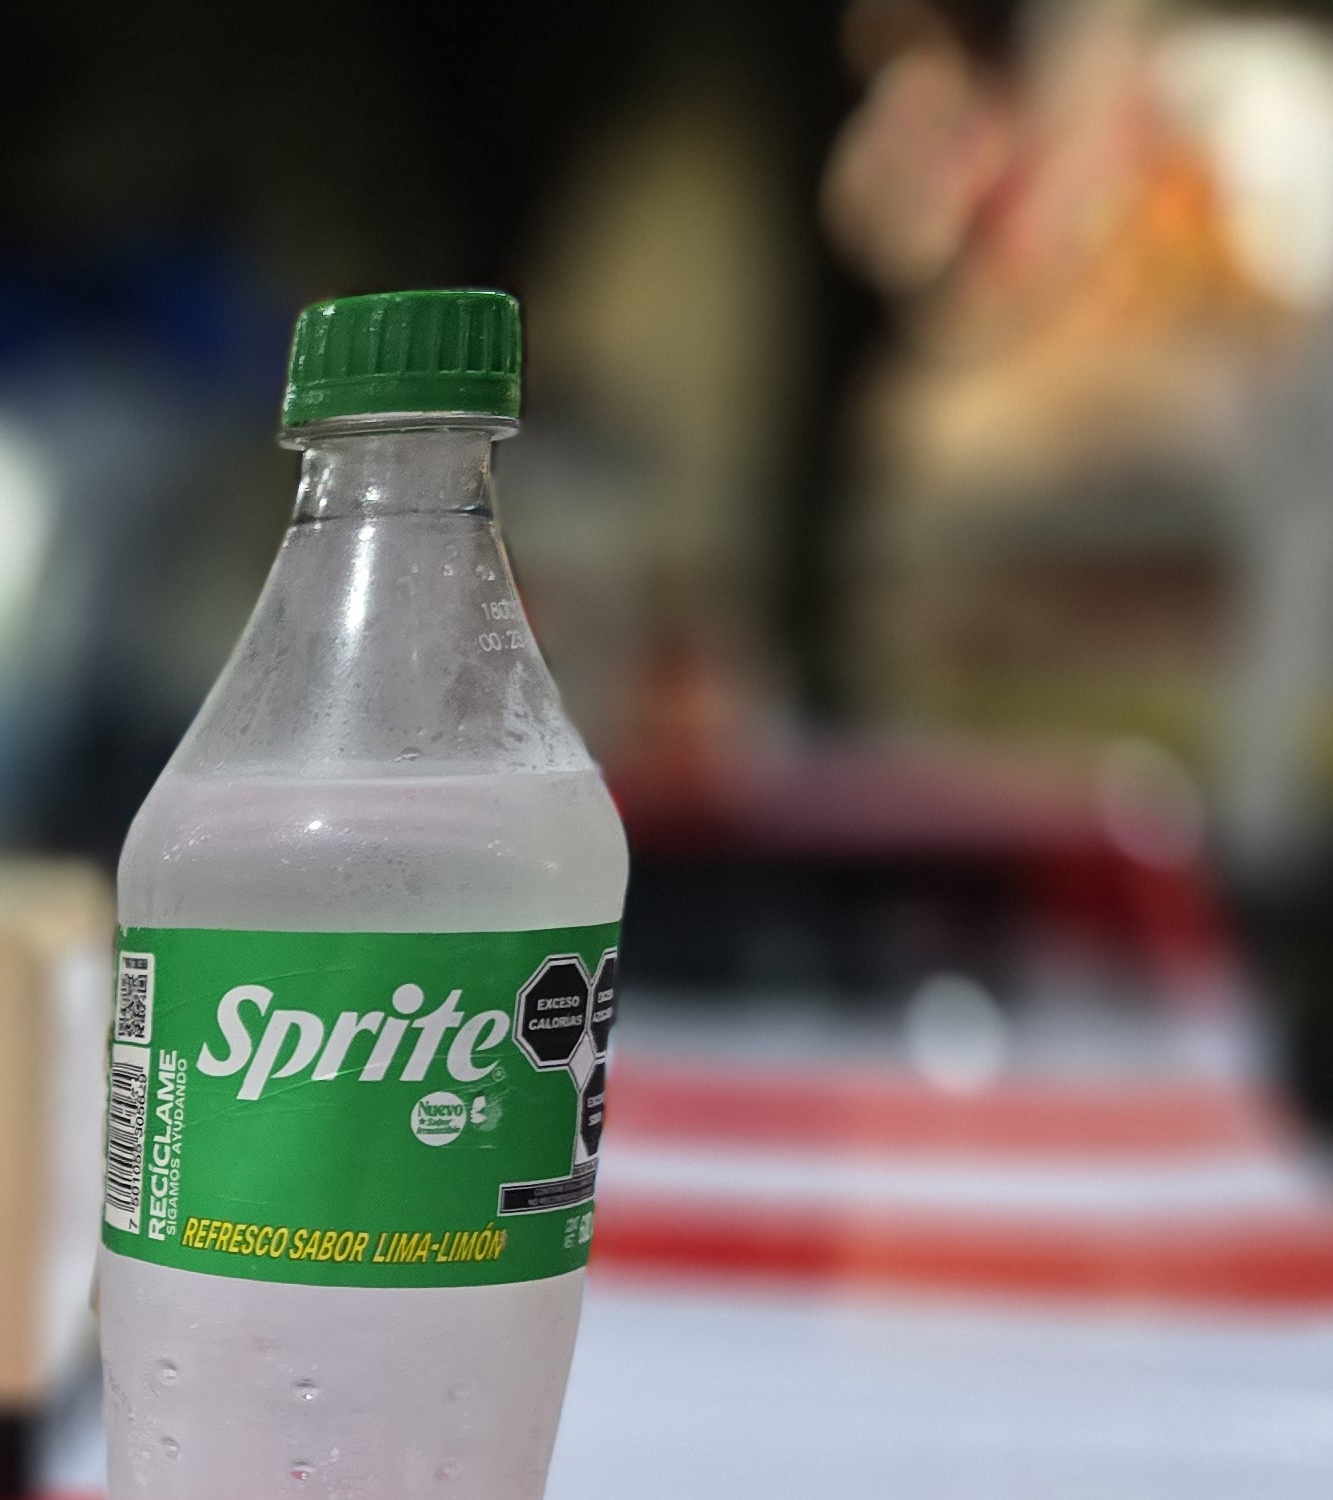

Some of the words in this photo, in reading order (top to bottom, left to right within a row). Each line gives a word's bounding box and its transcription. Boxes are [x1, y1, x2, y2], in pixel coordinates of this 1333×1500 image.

[528, 1012, 583, 1031] CALORÍAS
[536, 995, 580, 1011] EXCESO
[195, 983, 511, 1100] Sprite
[171, 1058, 188, 1155] AYUDANDO
[417, 1100, 464, 1117] Nuevo
[148, 1049, 178, 1242] RECÍCLAME
[131, 1144, 143, 1208] 501055
[166, 1157, 182, 1236] SIGAMOS
[128, 1218, 139, 1230] 7
[182, 1217, 289, 1258] REFRESCO
[288, 1228, 370, 1262] SABOR
[372, 1221, 508, 1263] LIMA-LIMÓN
